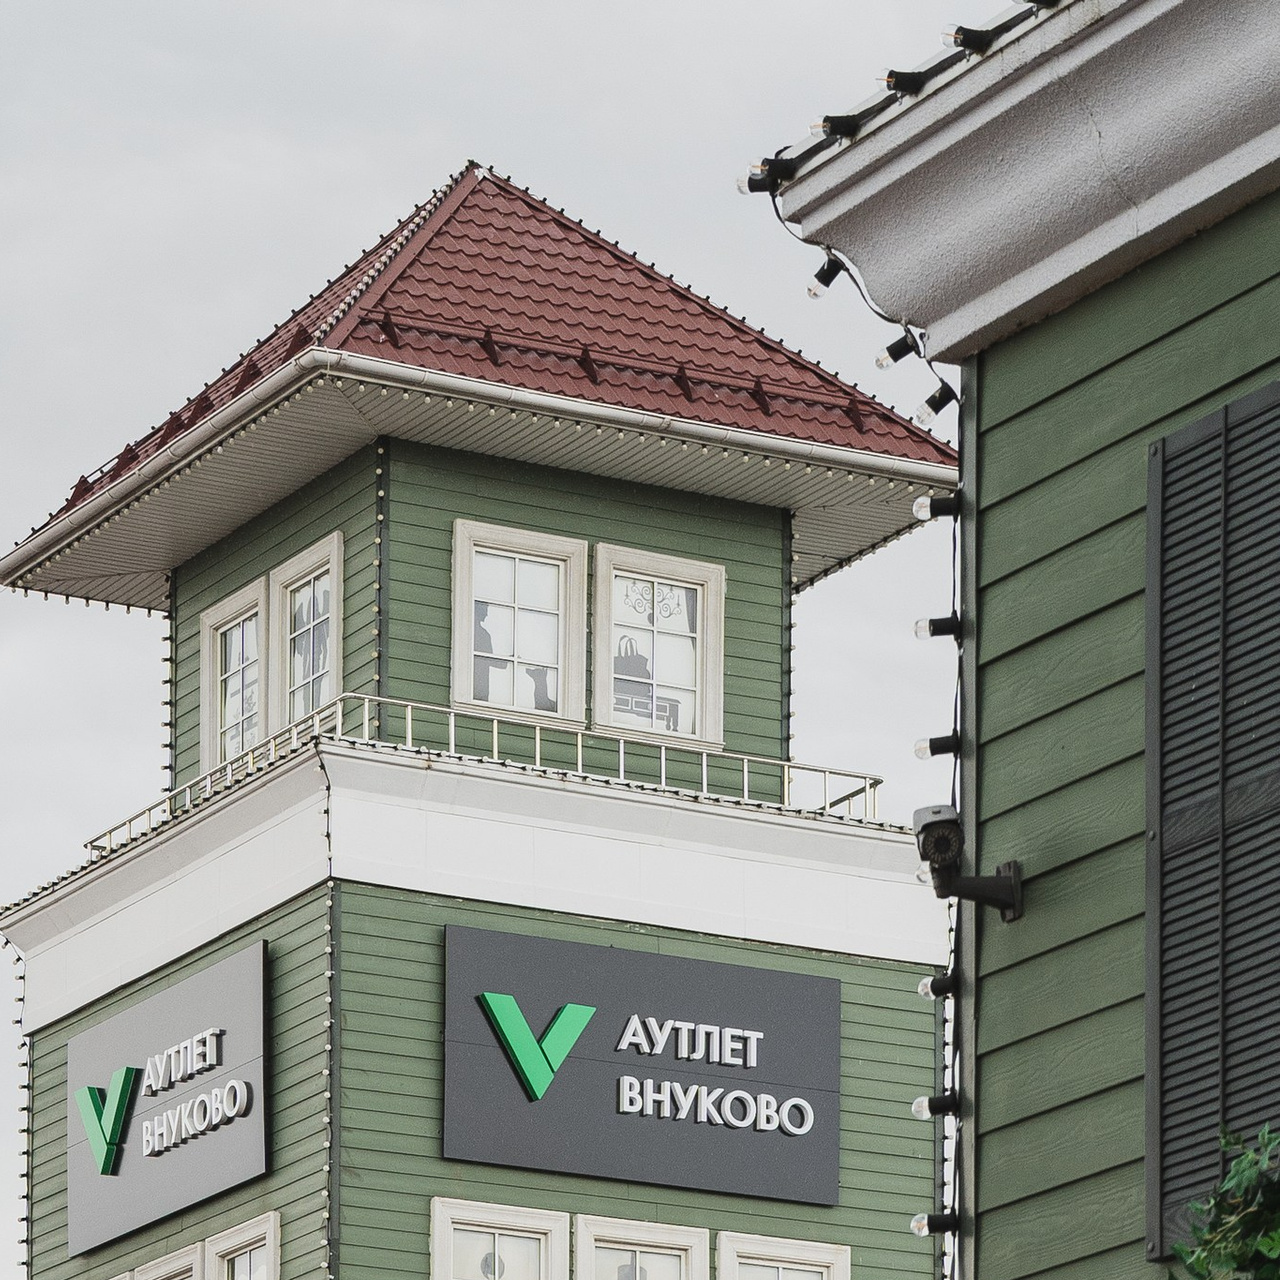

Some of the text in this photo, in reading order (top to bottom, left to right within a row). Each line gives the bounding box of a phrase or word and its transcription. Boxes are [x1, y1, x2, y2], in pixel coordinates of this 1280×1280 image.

[141, 1027, 225, 1097] АУТЛЕТ
[616, 1013, 764, 1068] АУТЛЕТ
[142, 1079, 248, 1157] ВНУКОВО
[619, 1075, 815, 1137] ВНУКОВО
